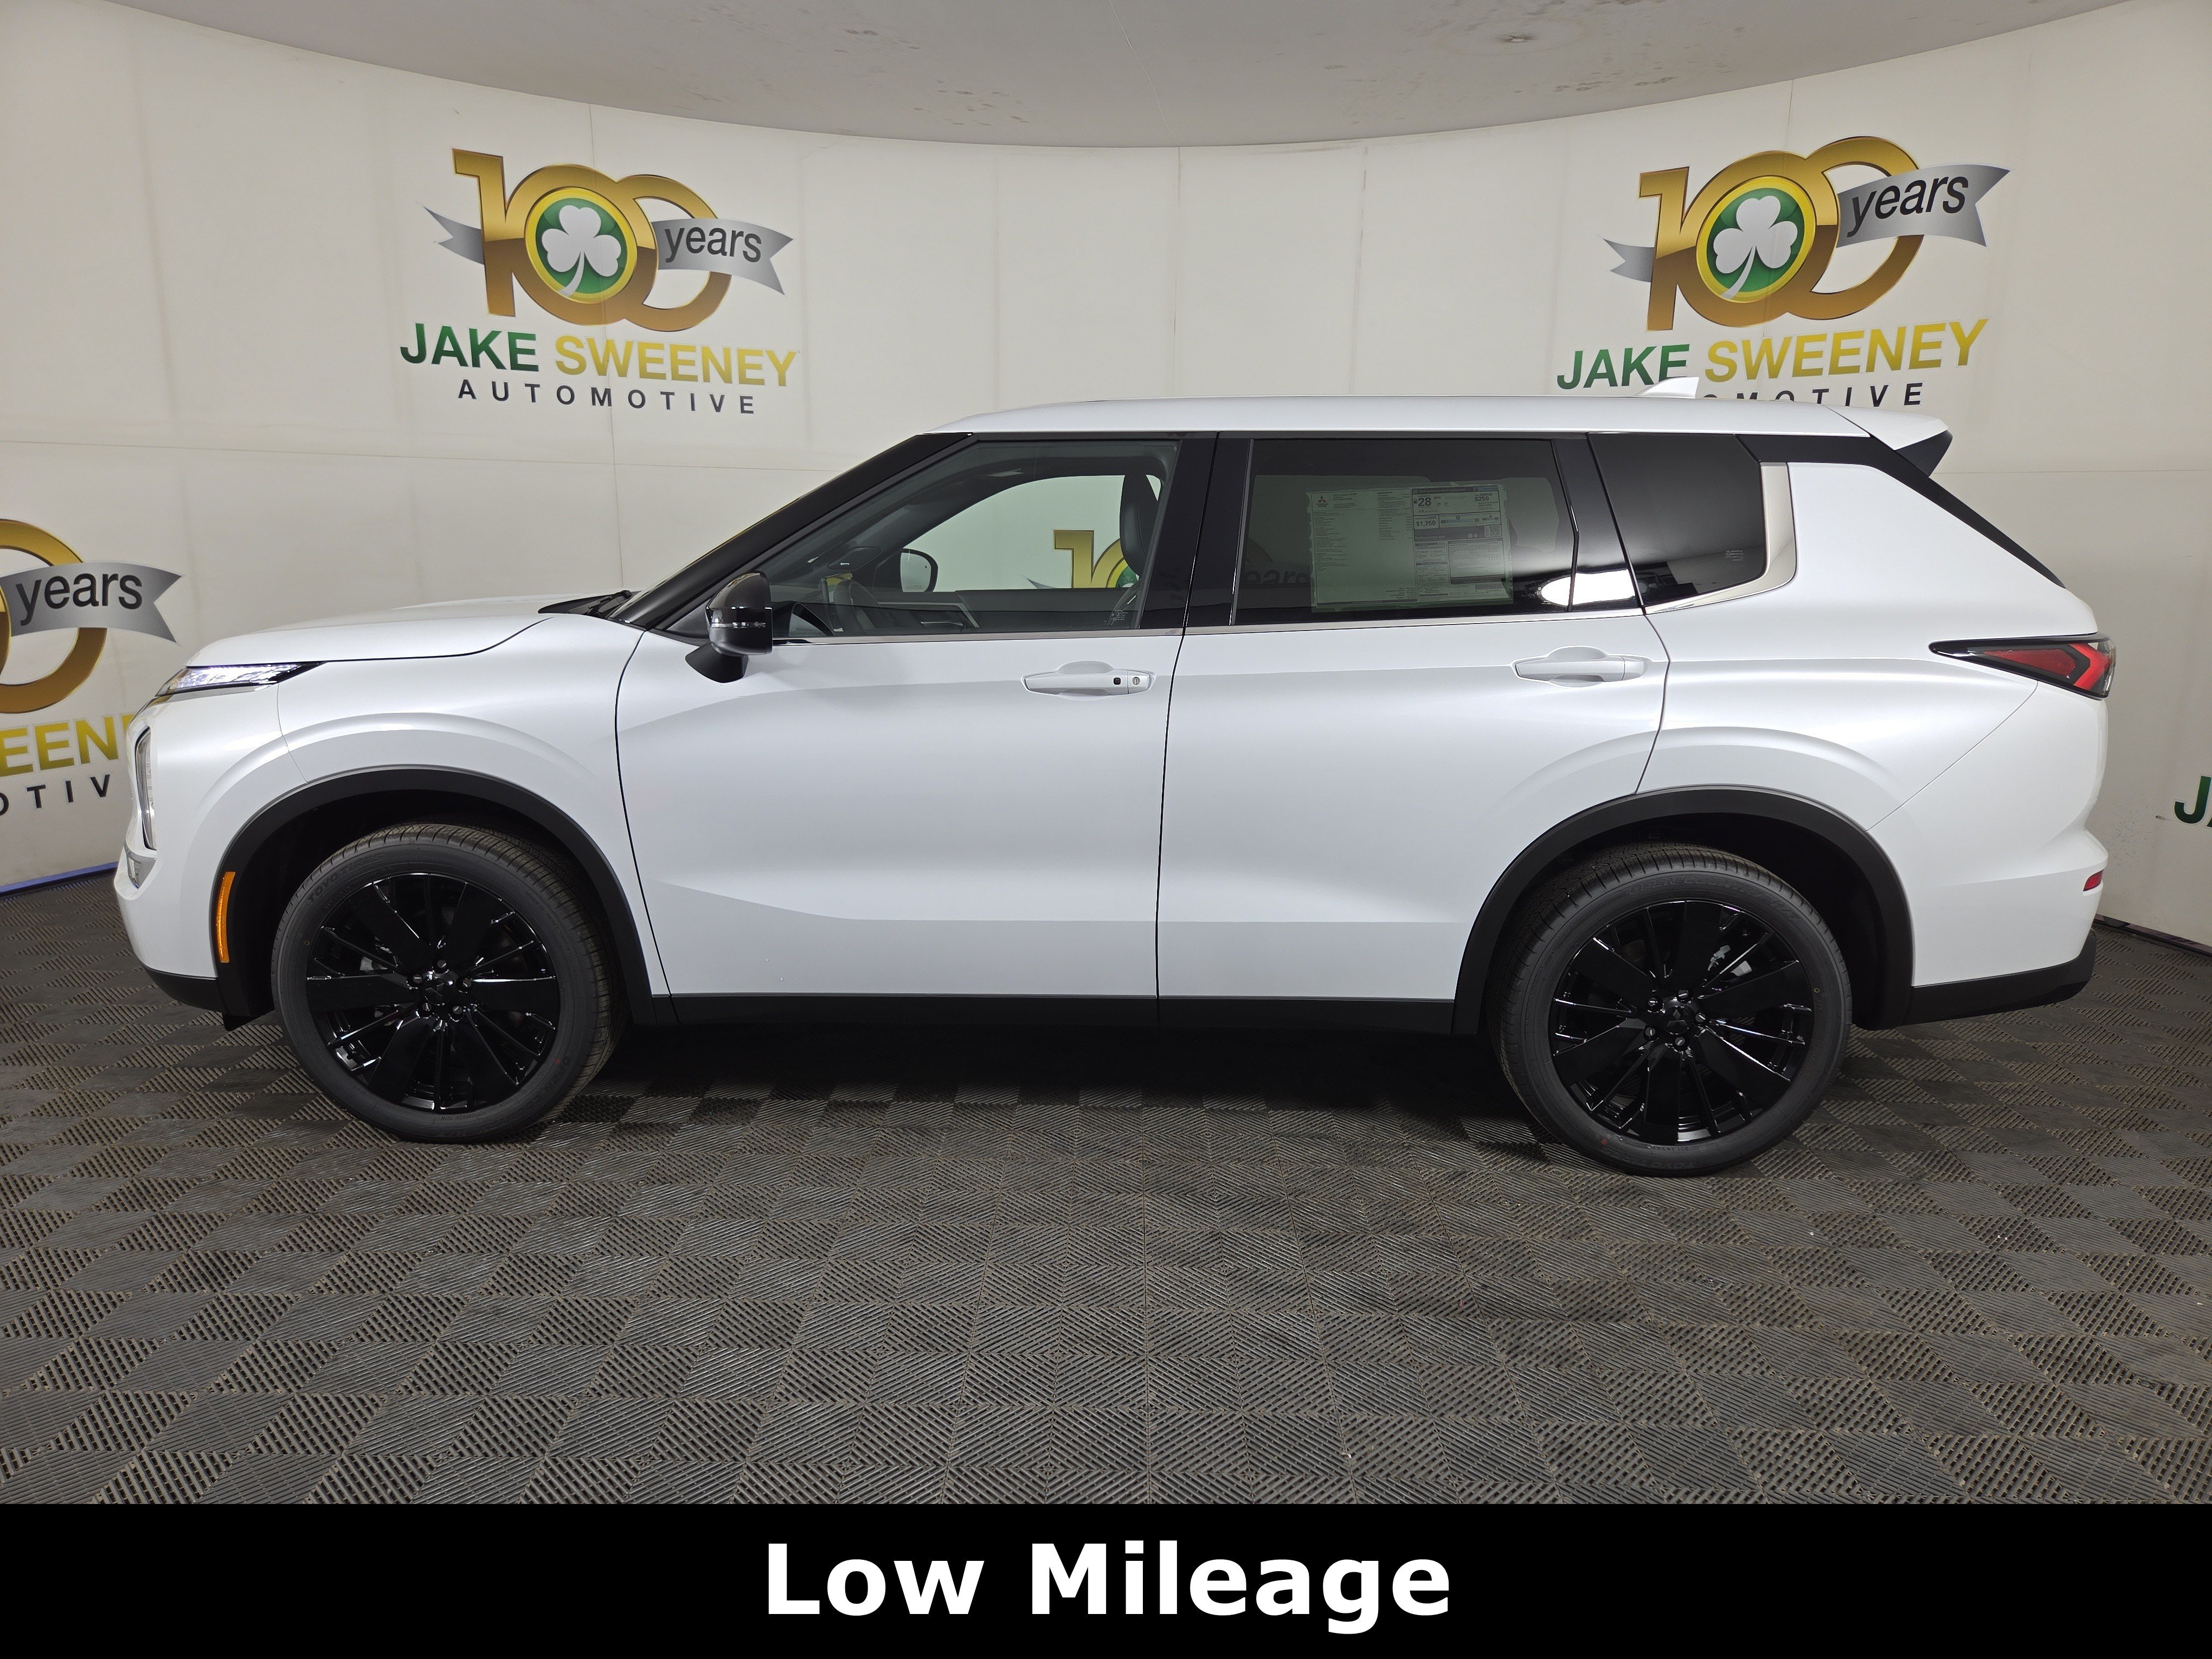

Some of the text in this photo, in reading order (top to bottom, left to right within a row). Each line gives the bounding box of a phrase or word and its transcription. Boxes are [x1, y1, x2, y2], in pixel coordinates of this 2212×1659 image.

[1847, 176, 1969, 239] years
[665, 226, 762, 263] years
[400, 323, 797, 387] JAKE SWEENEY
[1557, 318, 1989, 390] JAKE SWEENEY
[458, 379, 754, 415] AUTOMOTIVE
[1418, 497, 1431, 506] 28
[15, 572, 143, 627] years
[0, 713, 137, 777] EEN
